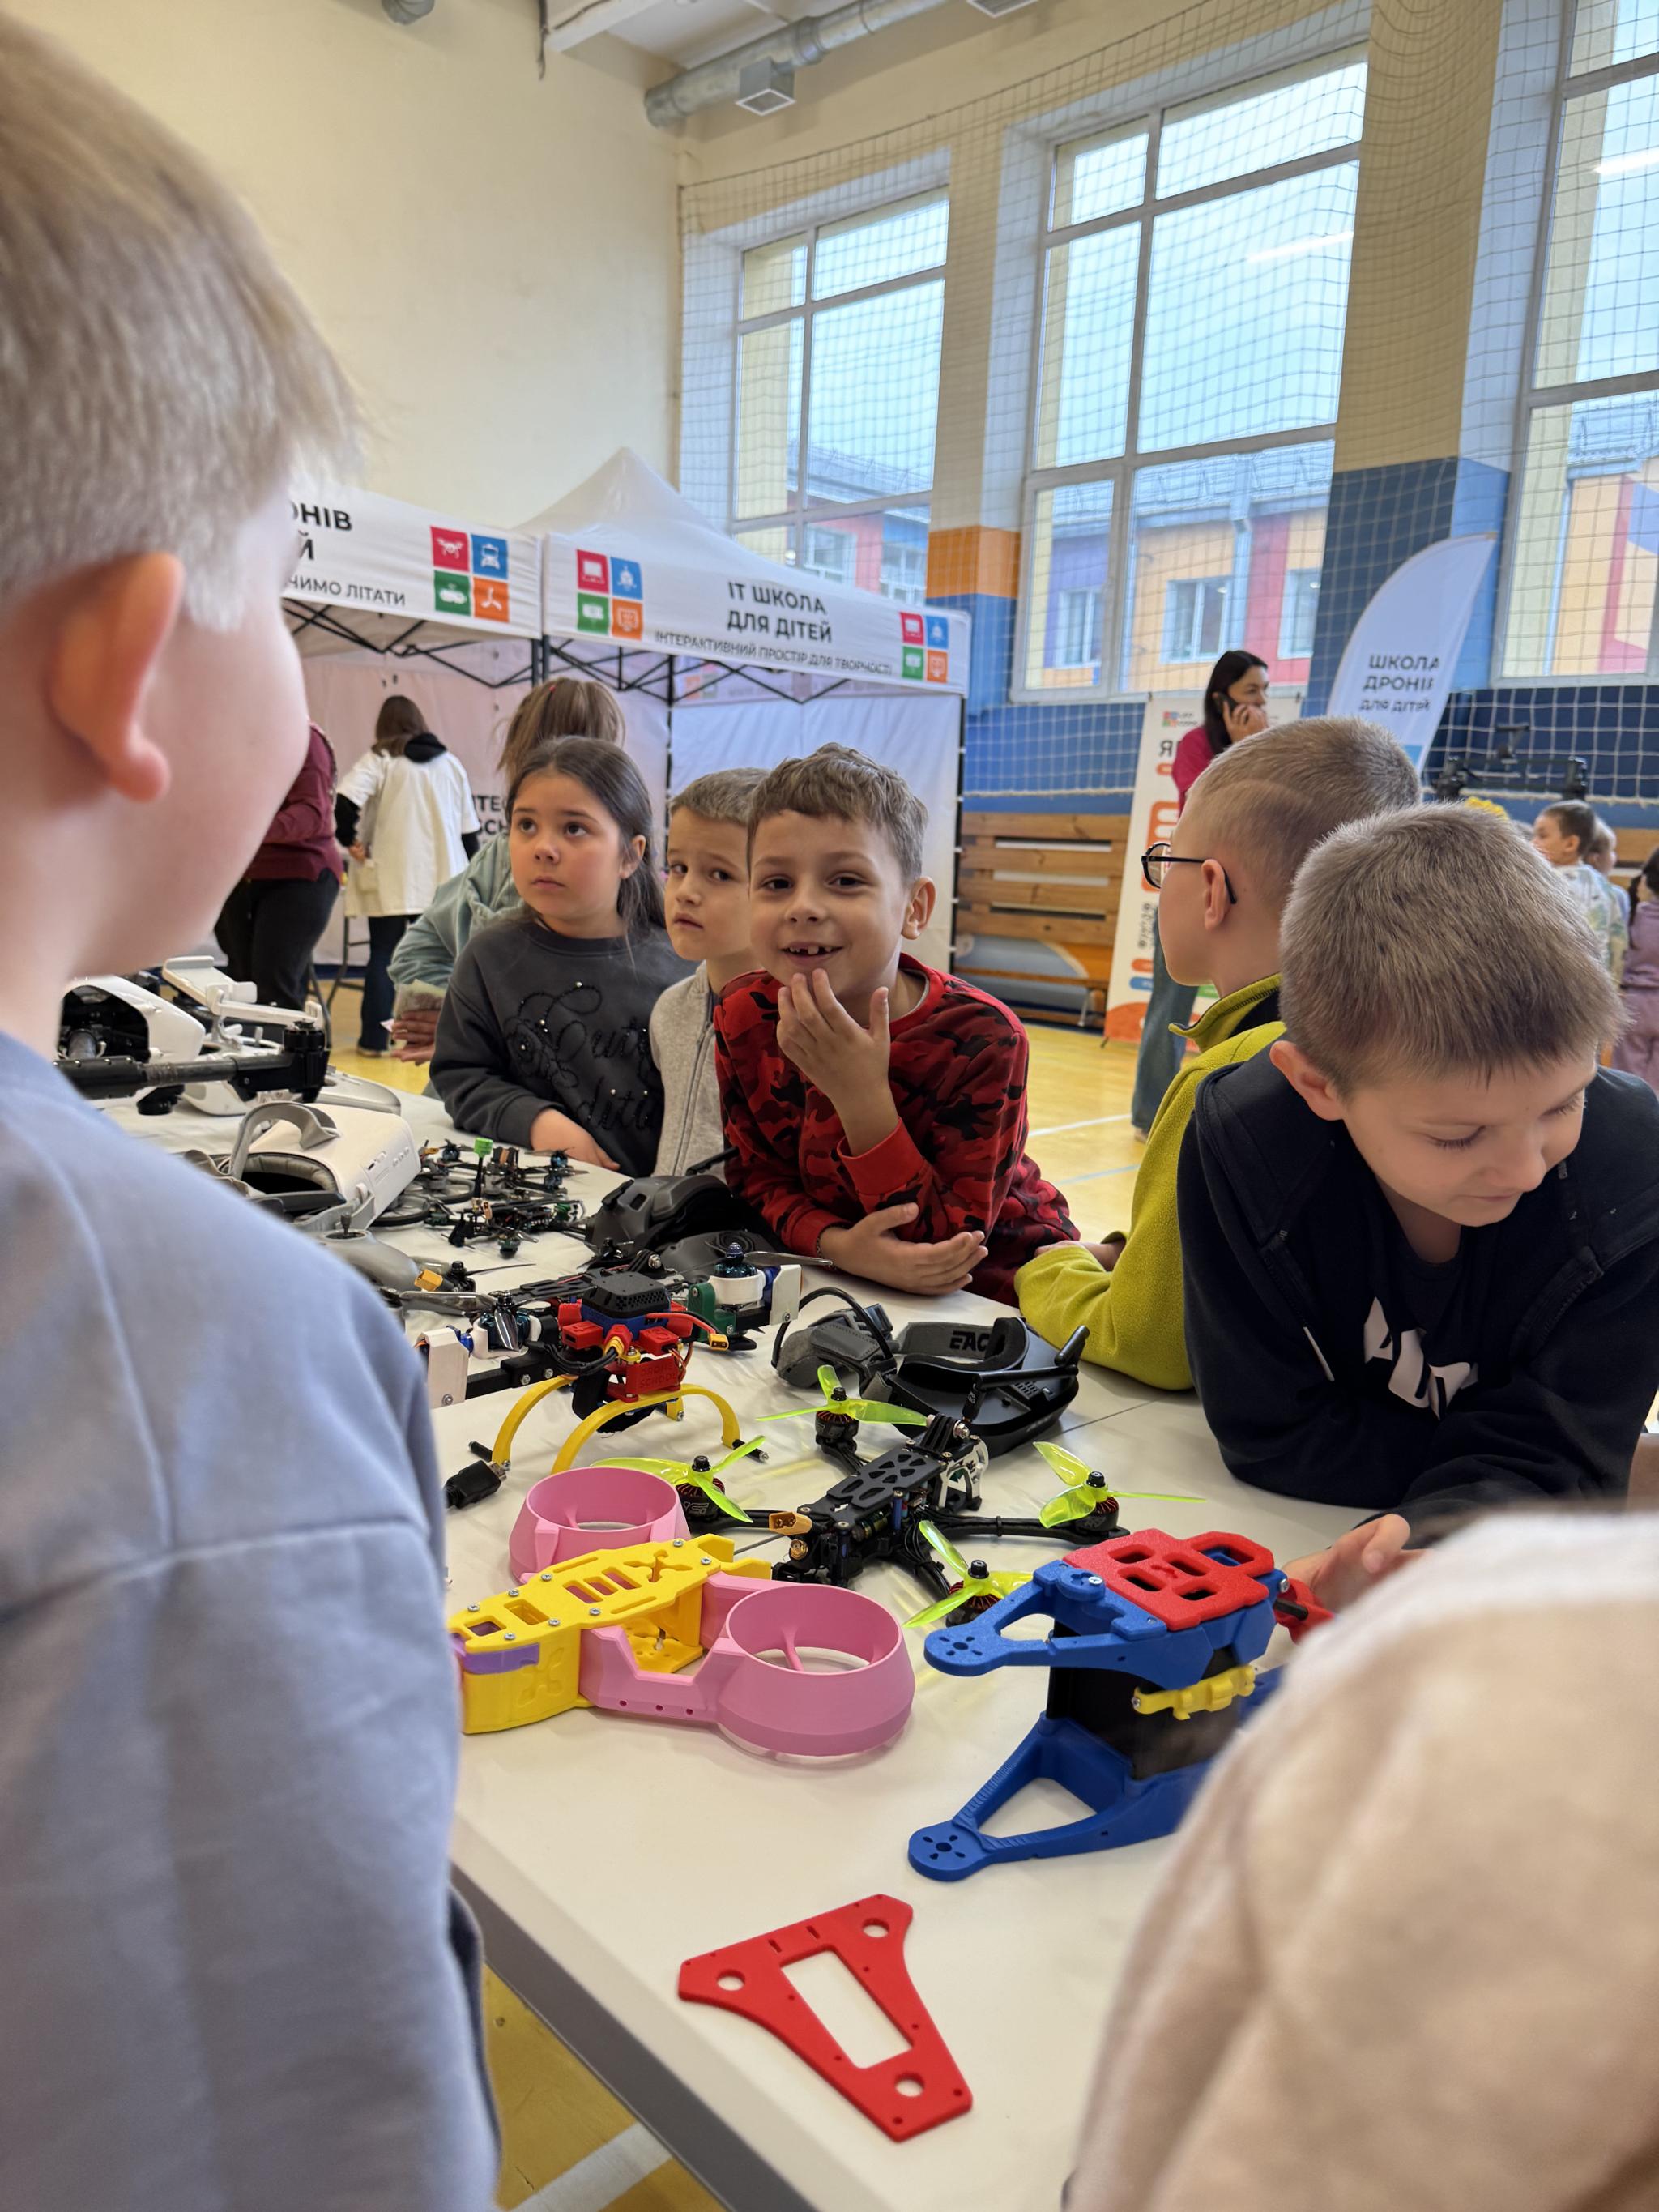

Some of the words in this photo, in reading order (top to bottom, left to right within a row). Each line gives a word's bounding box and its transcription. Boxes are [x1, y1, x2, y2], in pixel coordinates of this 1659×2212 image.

[347, 583, 406, 606] ЛІТАТИ
[752, 586, 827, 615] ШКОЛА
[727, 610, 769, 633] ДЛЯ
[775, 618, 832, 643] ДІТЕЙ
[655, 630, 757, 655] ІНТЕРАКТИВНИЙ
[758, 647, 808, 662] ПРОСТІР
[808, 653, 833, 667] ДЛЯ
[1369, 655, 1439, 671] ШКОЛА
